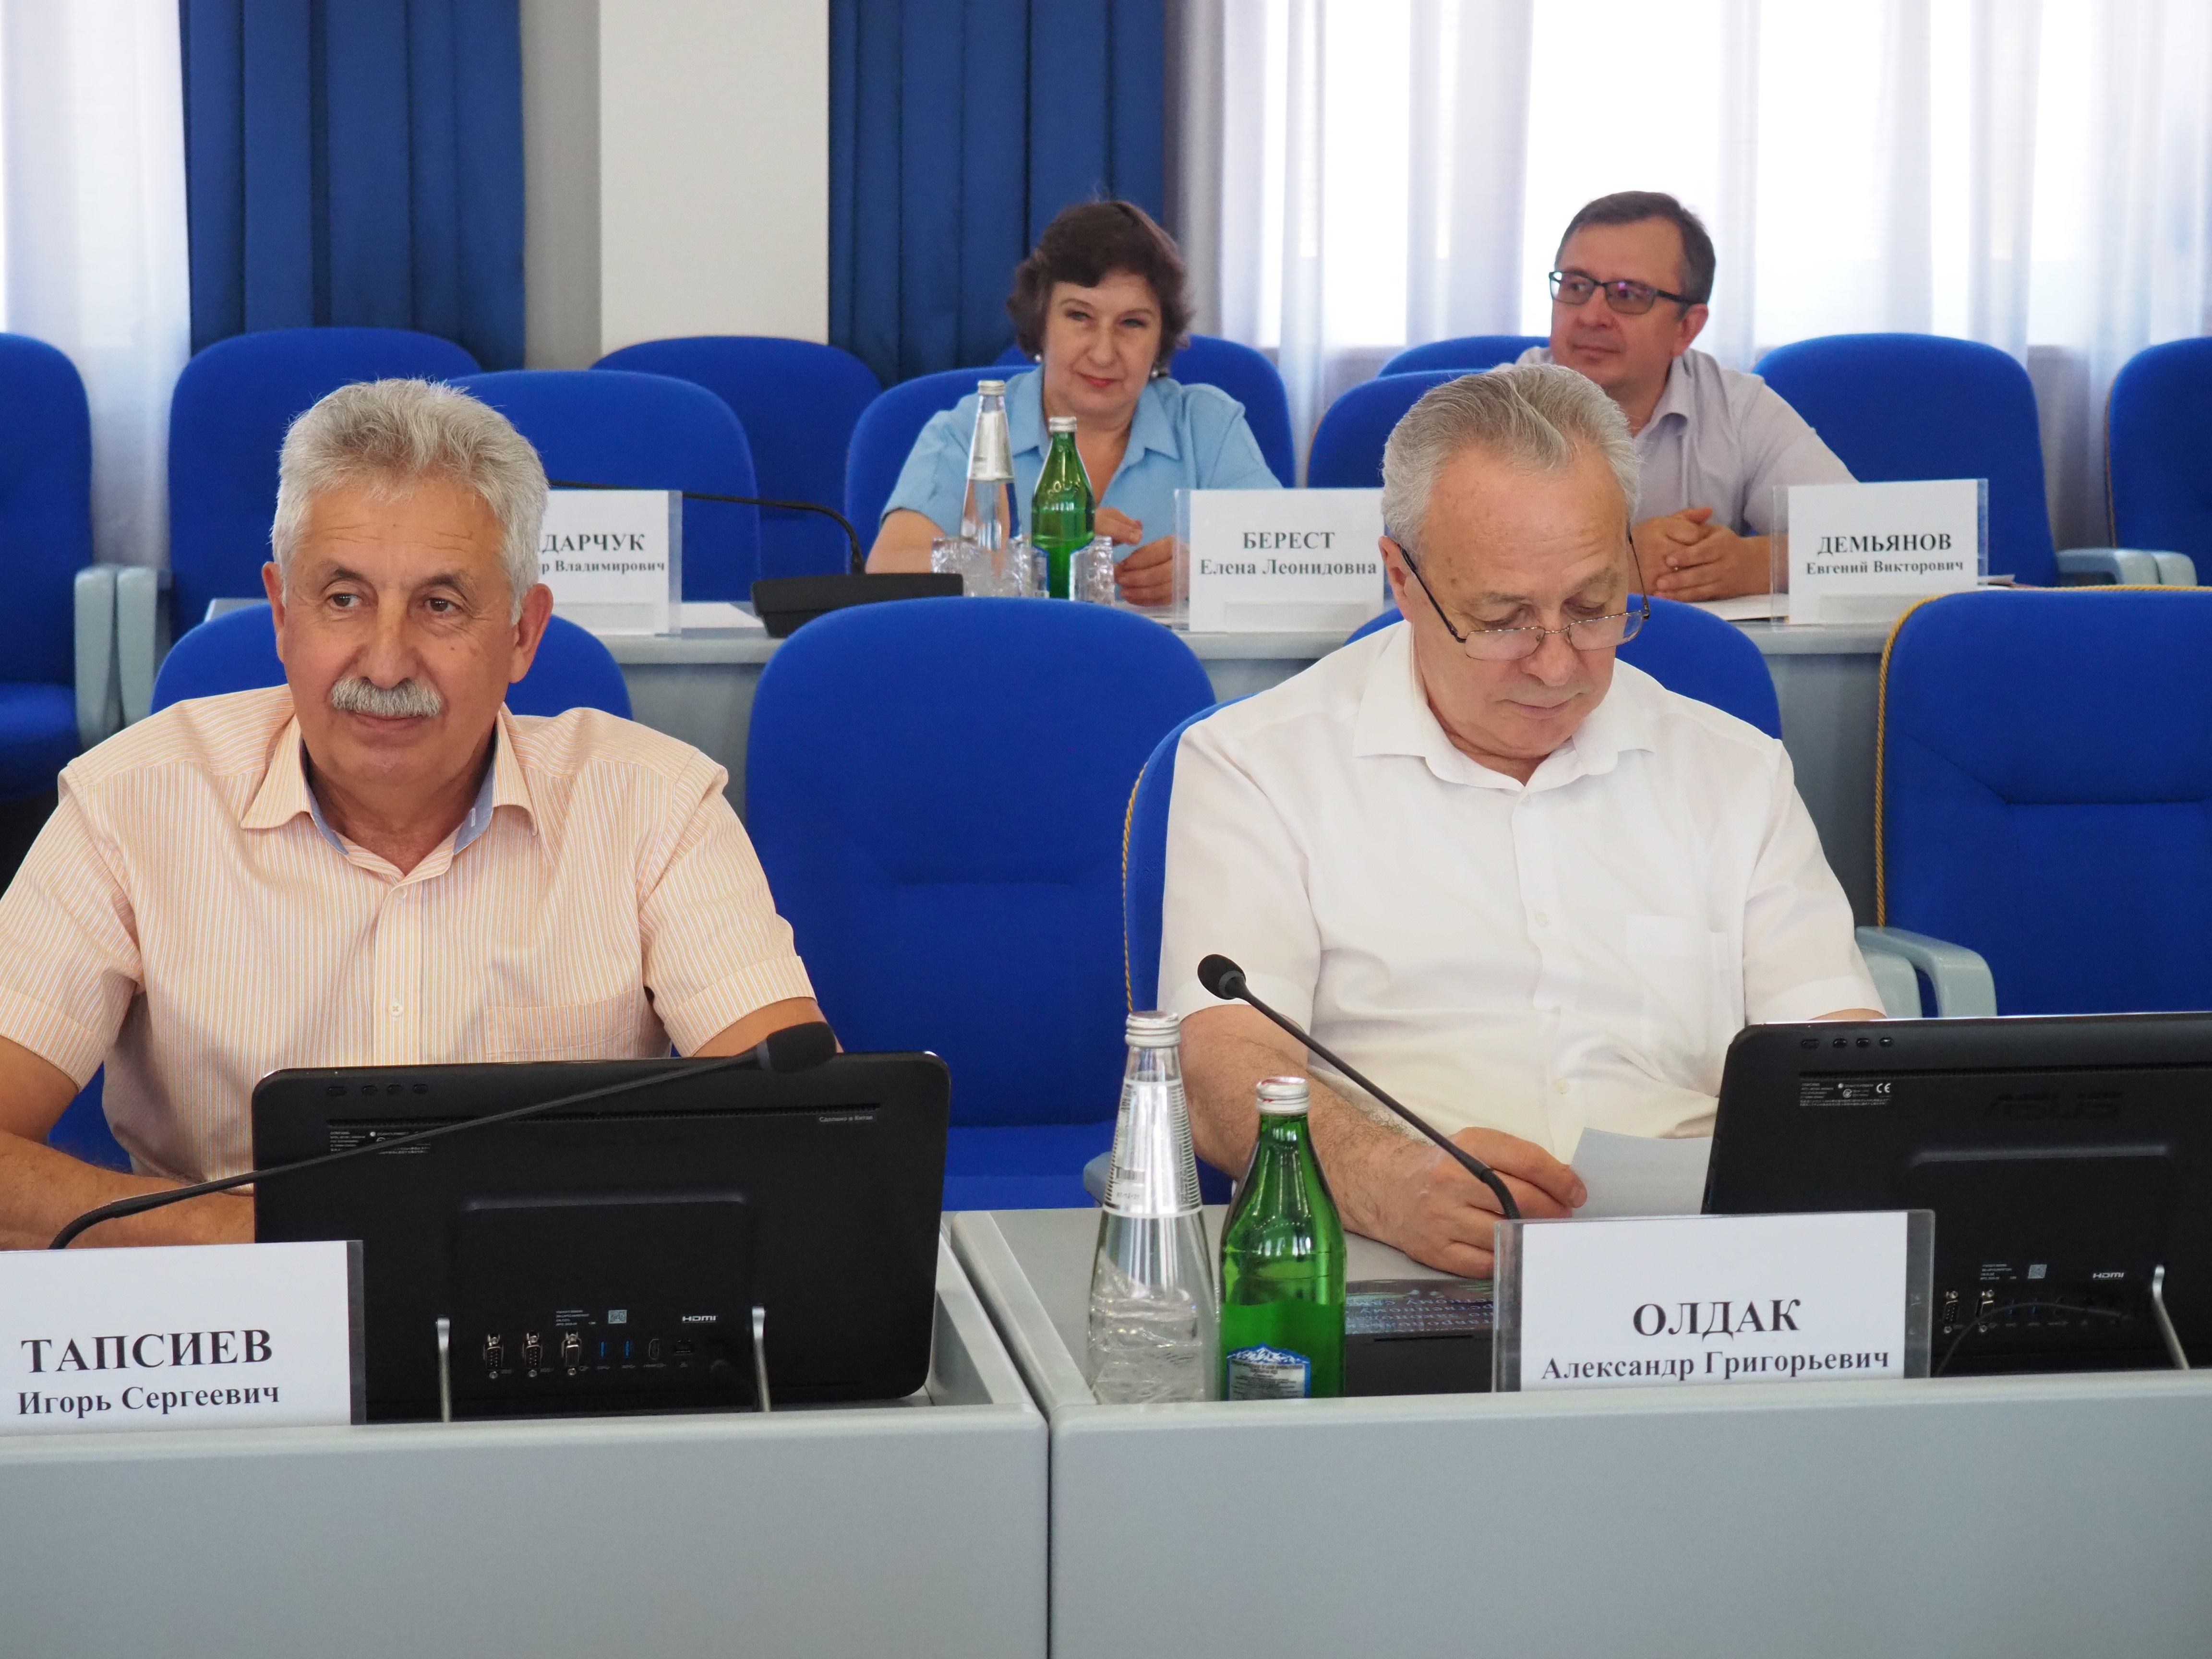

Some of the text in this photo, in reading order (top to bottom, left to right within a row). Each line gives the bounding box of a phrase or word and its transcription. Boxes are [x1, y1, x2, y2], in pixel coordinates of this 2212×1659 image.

[542, 534, 645, 553] ДАРЧУК
[1243, 532, 1335, 549] БЕРЕСТ
[1817, 533, 1951, 555] ДЕМЬЯНОВ
[555, 560, 665, 575] Владимирович
[1200, 559, 1377, 576] Елена Леонидовна
[1806, 560, 1963, 576] Евгений Викторович
[1633, 1298, 1802, 1341] ОЛДАК
[21, 1329, 273, 1373] ТАПСИЕВ
[1541, 1351, 1889, 1382] Александр Григорьевич
[18, 1386, 279, 1419] Игорь Сергеевич
